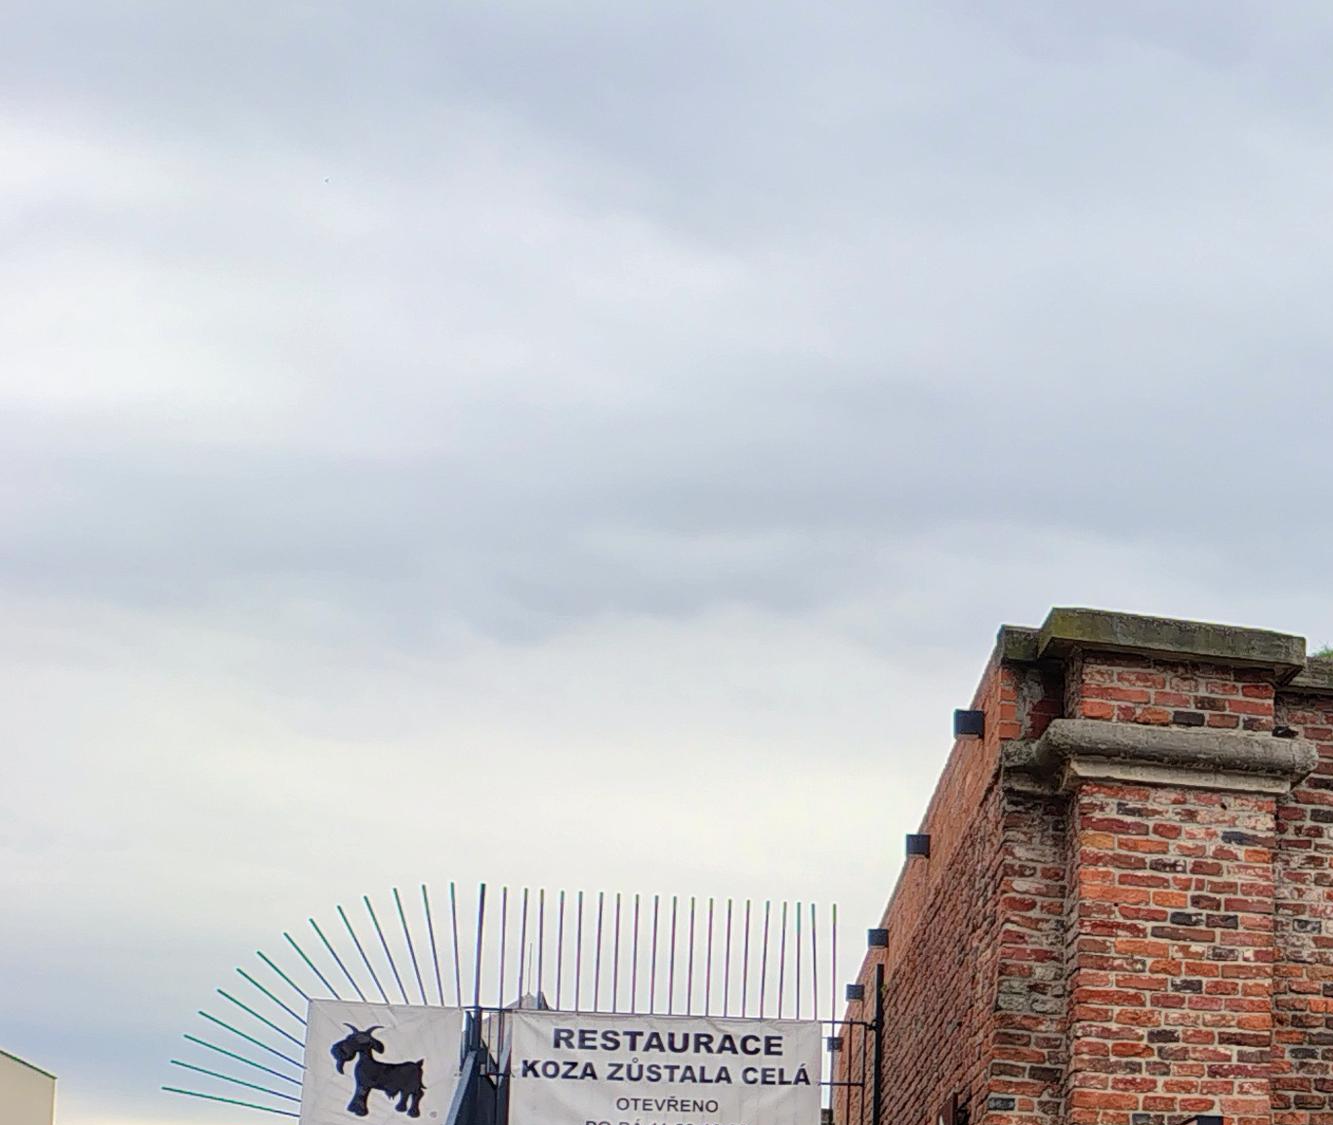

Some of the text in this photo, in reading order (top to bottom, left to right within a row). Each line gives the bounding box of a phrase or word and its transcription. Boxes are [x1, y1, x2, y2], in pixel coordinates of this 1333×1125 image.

[553, 1027, 784, 1056] RESTAURACE
[521, 1057, 811, 1086] KOZA ZŮSTALA CELÁ
[616, 1096, 719, 1113] OTEVŘENO
